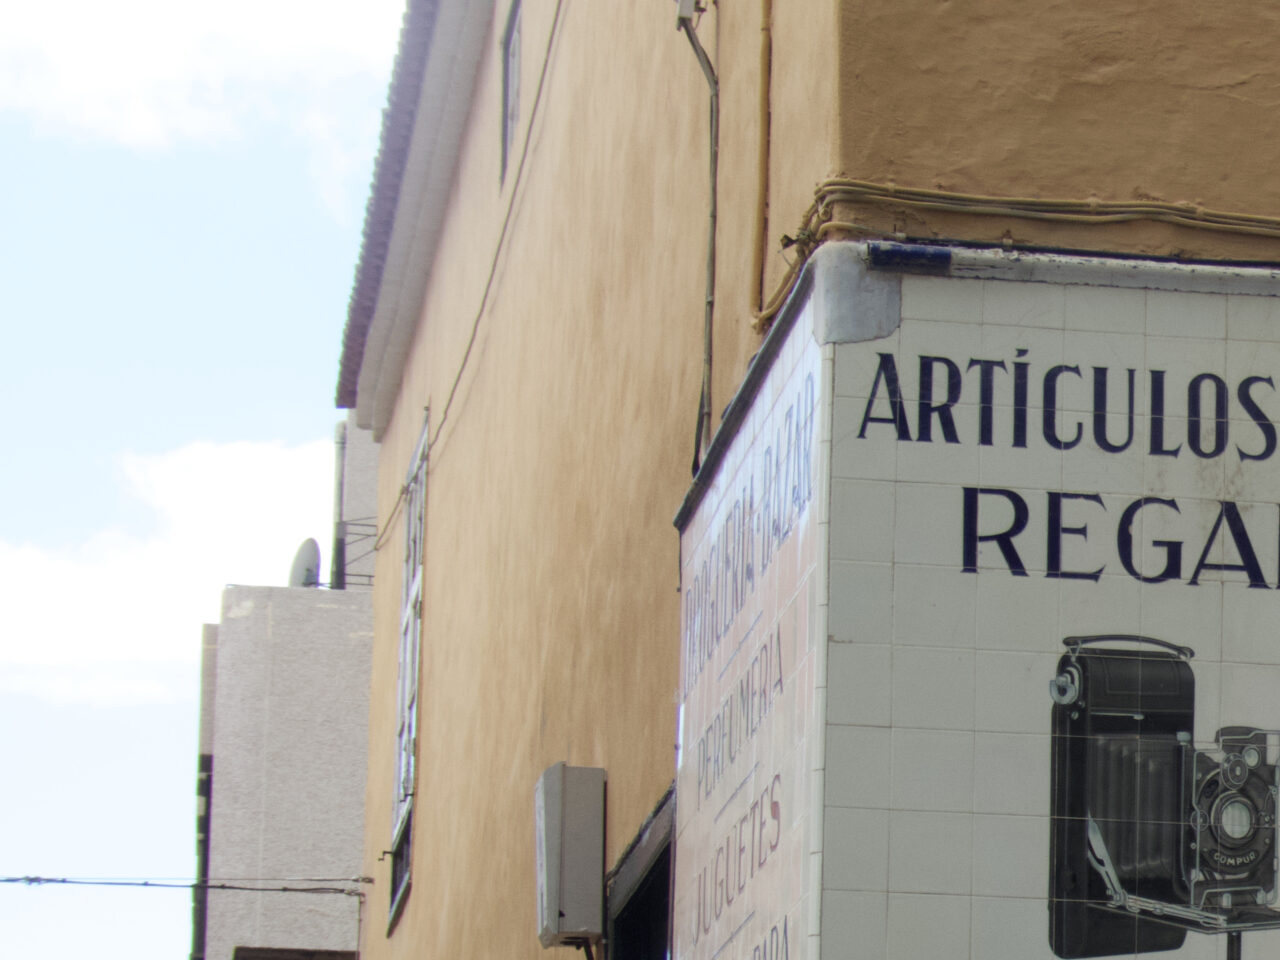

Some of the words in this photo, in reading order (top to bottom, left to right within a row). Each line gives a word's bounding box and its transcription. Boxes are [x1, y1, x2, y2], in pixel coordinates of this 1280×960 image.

[761, 371, 814, 577] BAZAR
[856, 348, 1278, 463] ARTÍCULOS
[697, 622, 783, 812] PERFUMERIA
[693, 774, 781, 945] JUGUETES
[1213, 851, 1257, 867] COMPUR
